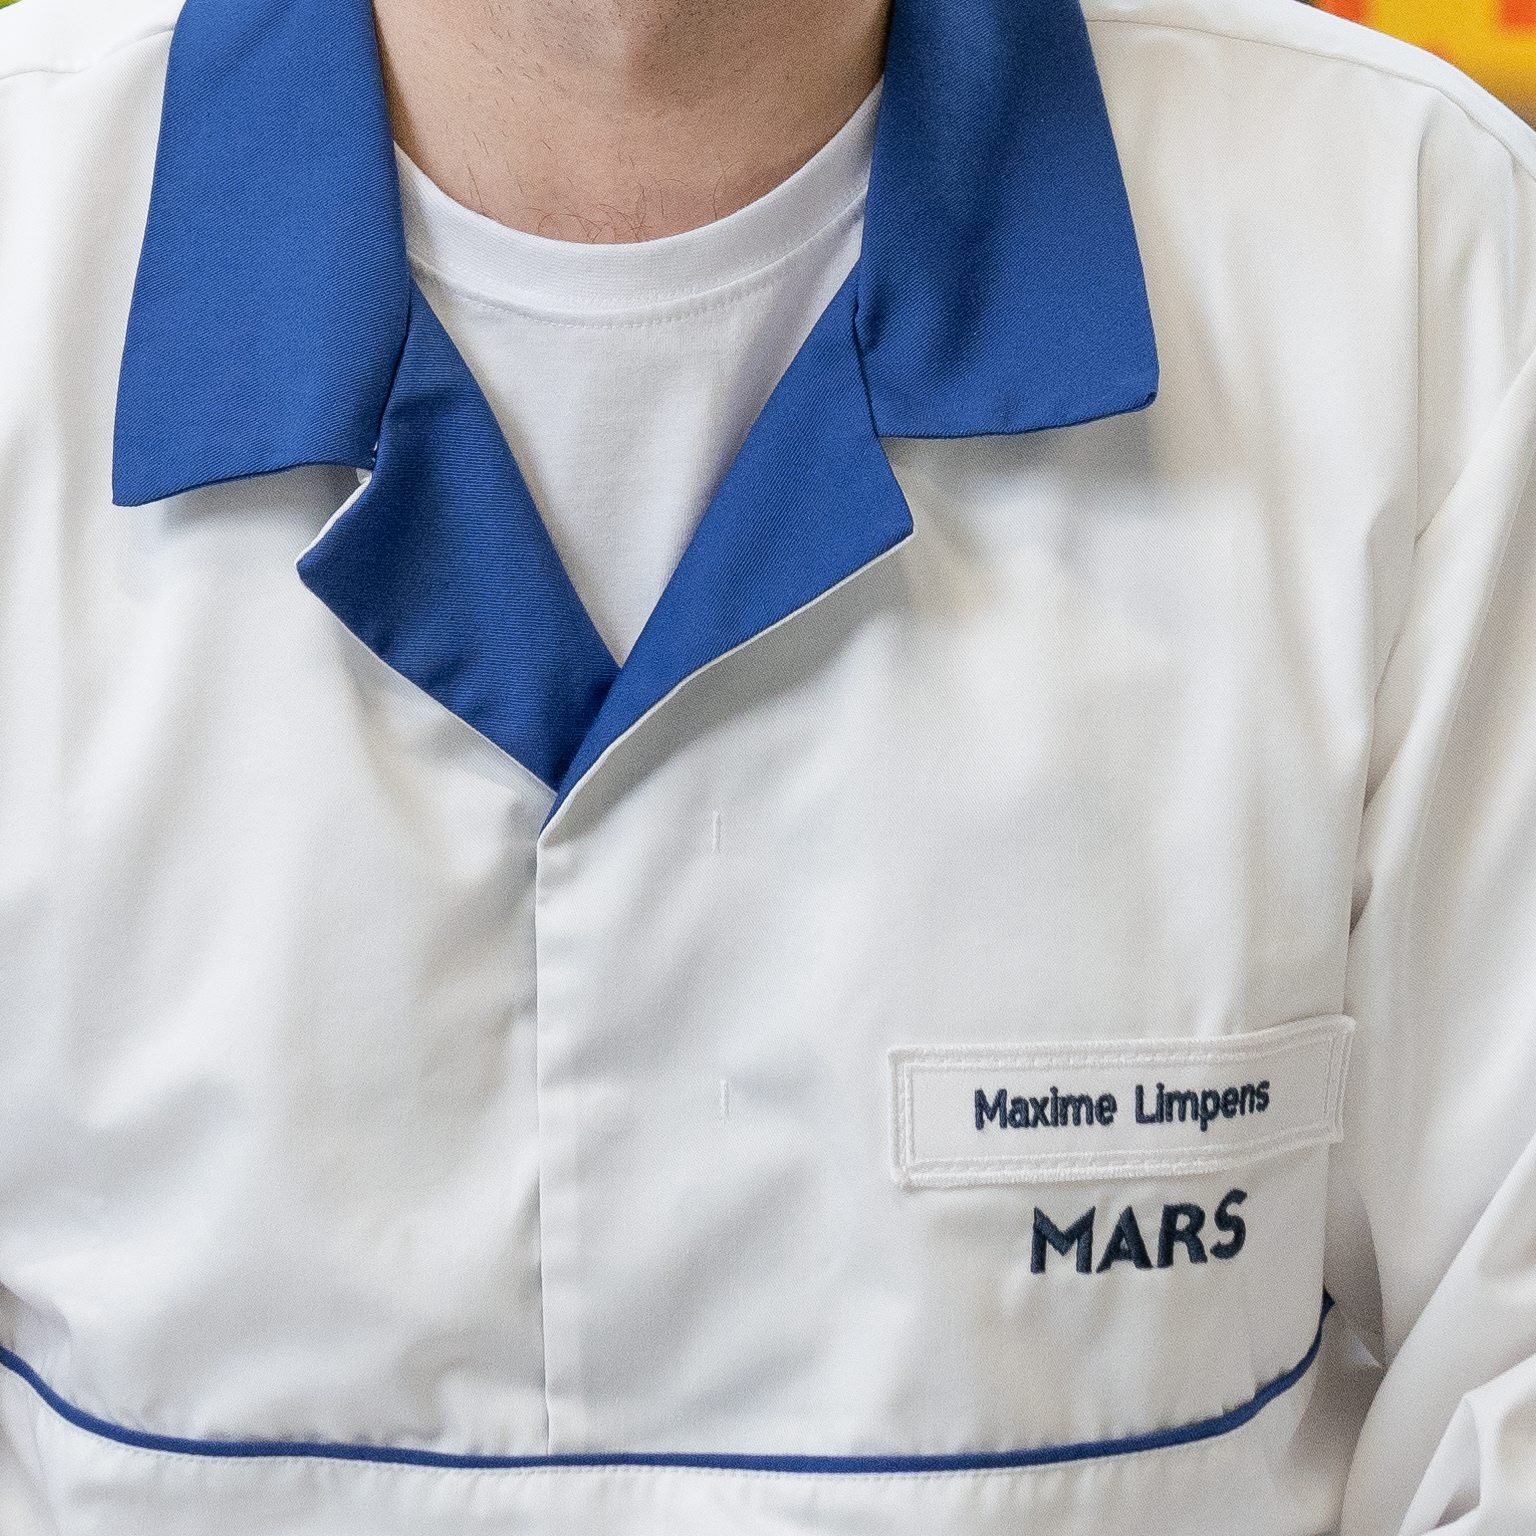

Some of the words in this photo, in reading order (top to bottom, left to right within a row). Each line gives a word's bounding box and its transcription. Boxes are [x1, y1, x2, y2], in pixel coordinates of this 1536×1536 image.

[974, 1086, 1118, 1131] Maxime
[1134, 1080, 1271, 1132] Limpens
[1029, 1187, 1248, 1275] MARS
